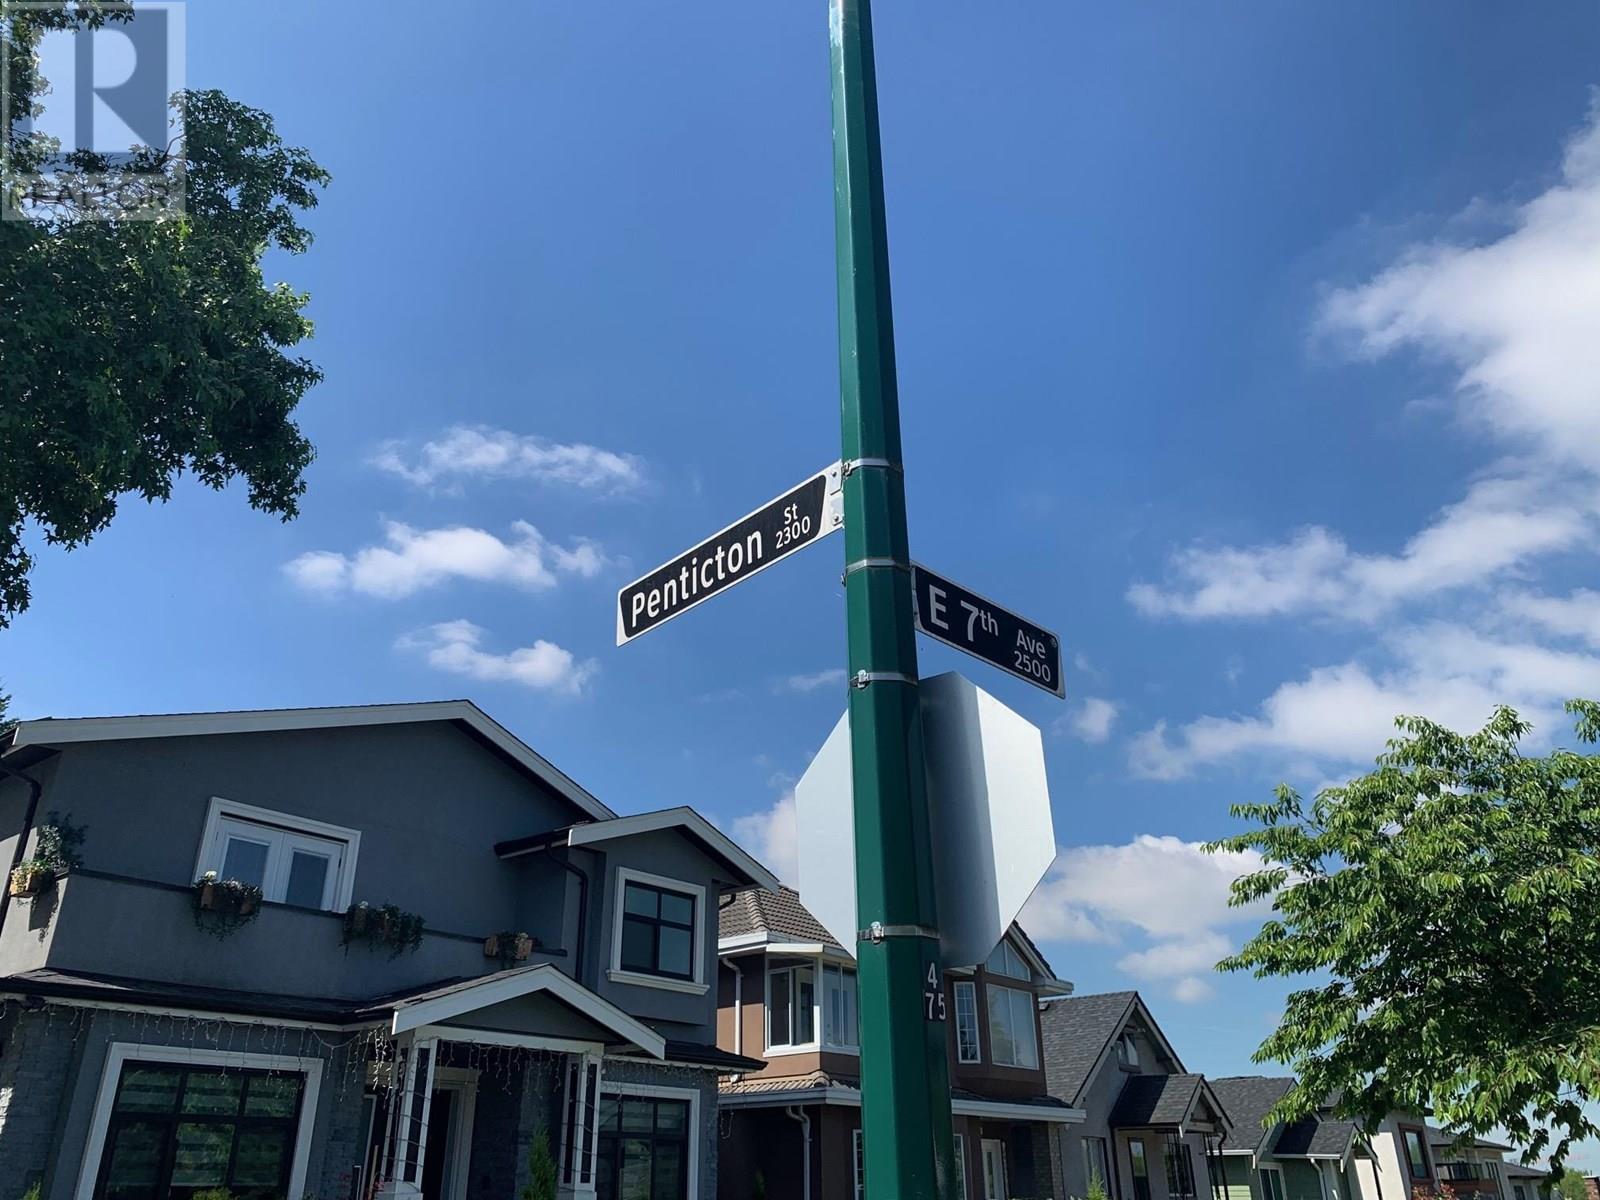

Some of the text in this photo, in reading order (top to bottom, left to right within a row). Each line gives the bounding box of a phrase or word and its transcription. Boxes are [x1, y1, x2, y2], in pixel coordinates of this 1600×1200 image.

[776, 516, 811, 549] 2300
[631, 503, 798, 628] Penticton St
[929, 584, 1046, 659] E 7th Ave
[1014, 651, 1051, 682] 2500
[927, 962, 938, 989] 4
[925, 992, 946, 1020] 75
